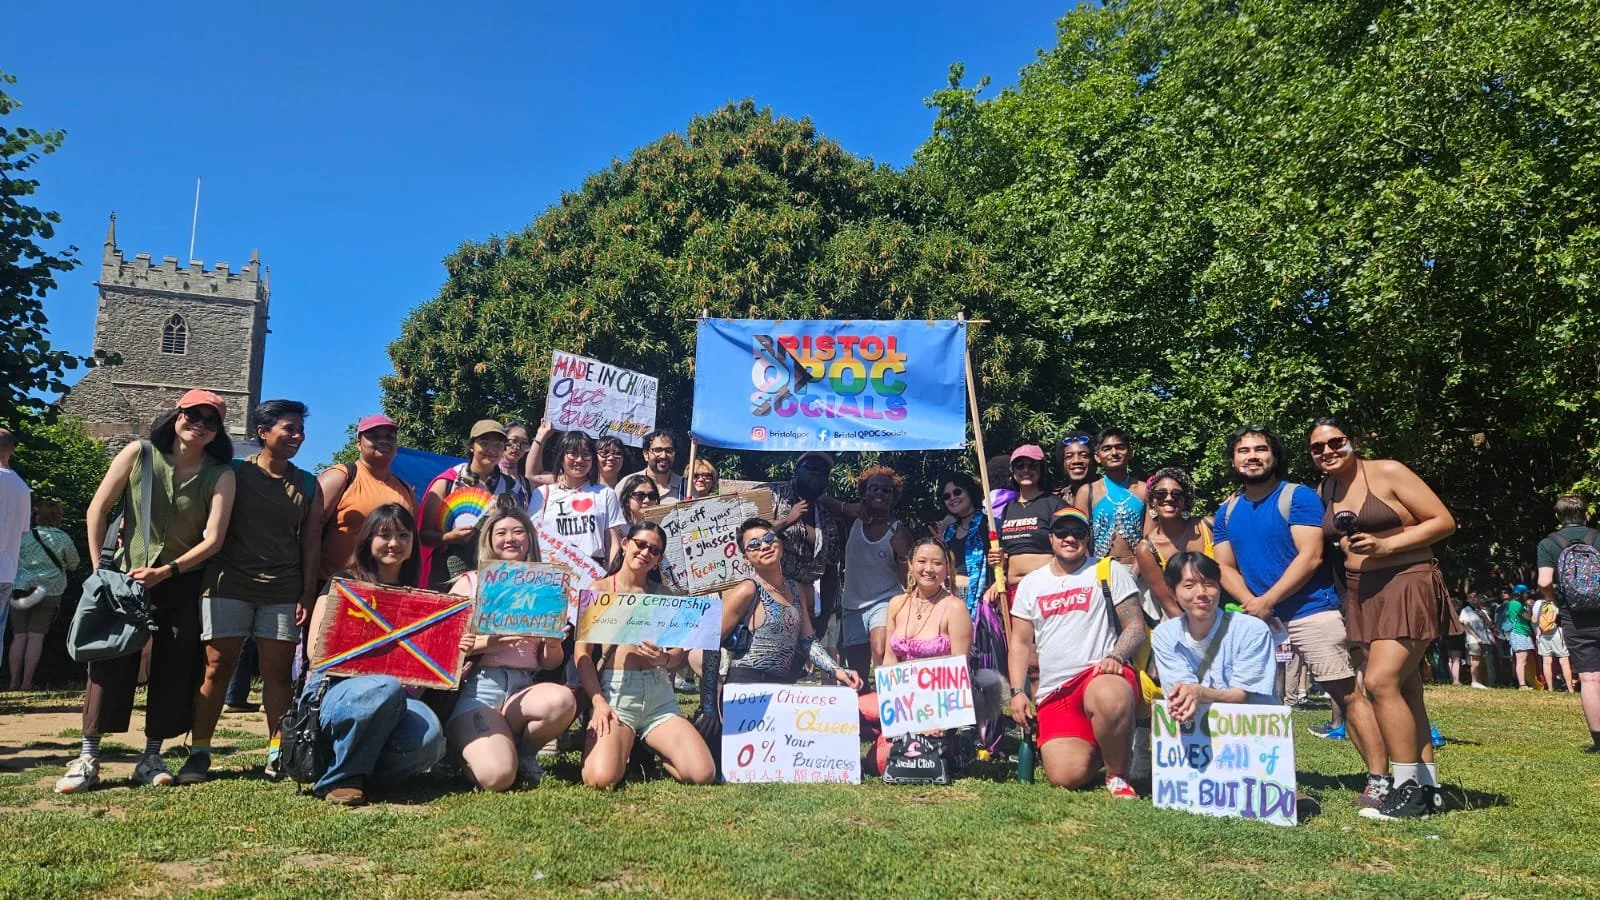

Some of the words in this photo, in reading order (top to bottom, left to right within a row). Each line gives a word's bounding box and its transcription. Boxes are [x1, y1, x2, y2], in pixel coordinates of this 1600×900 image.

[752, 334, 907, 362] BRISTOL
[553, 356, 594, 382] MADE
[598, 366, 617, 388] IN
[617, 371, 656, 399] CHINA
[752, 359, 907, 396] QPOC
[750, 391, 907, 421] SOCIALS
[769, 430, 809, 440] bristolqpoc
[834, 431, 857, 439] Bristol
[857, 430, 881, 439] QPOC
[556, 501, 567, 516] I
[556, 514, 596, 536] MILFS
[663, 520, 687, 537] Take
[690, 506, 706, 523] off
[710, 508, 730, 526] your
[696, 532, 736, 556] glasses
[484, 570, 509, 584] NO
[513, 569, 571, 590] BORDER
[510, 592, 537, 610] IN
[587, 593, 611, 607] NO
[618, 595, 637, 606] TO
[878, 668, 909, 695] MADE
[917, 664, 971, 691] CHINA
[730, 690, 769, 705] 100%
[776, 689, 838, 706] Chinese
[880, 692, 916, 726] GAY
[916, 704, 934, 723] AS
[937, 690, 973, 719] HELL
[738, 716, 776, 733] 100%
[795, 709, 858, 736] Queer
[784, 734, 815, 748] Your
[792, 752, 857, 771] Business
[917, 758, 936, 769] Club
[1156, 741, 1211, 769] LOVES
[1259, 746, 1280, 775] of
[1156, 779, 1193, 807] ME,
[1199, 779, 1239, 808] BUT
[1240, 777, 1256, 818] I
[1260, 781, 1296, 818] DO
